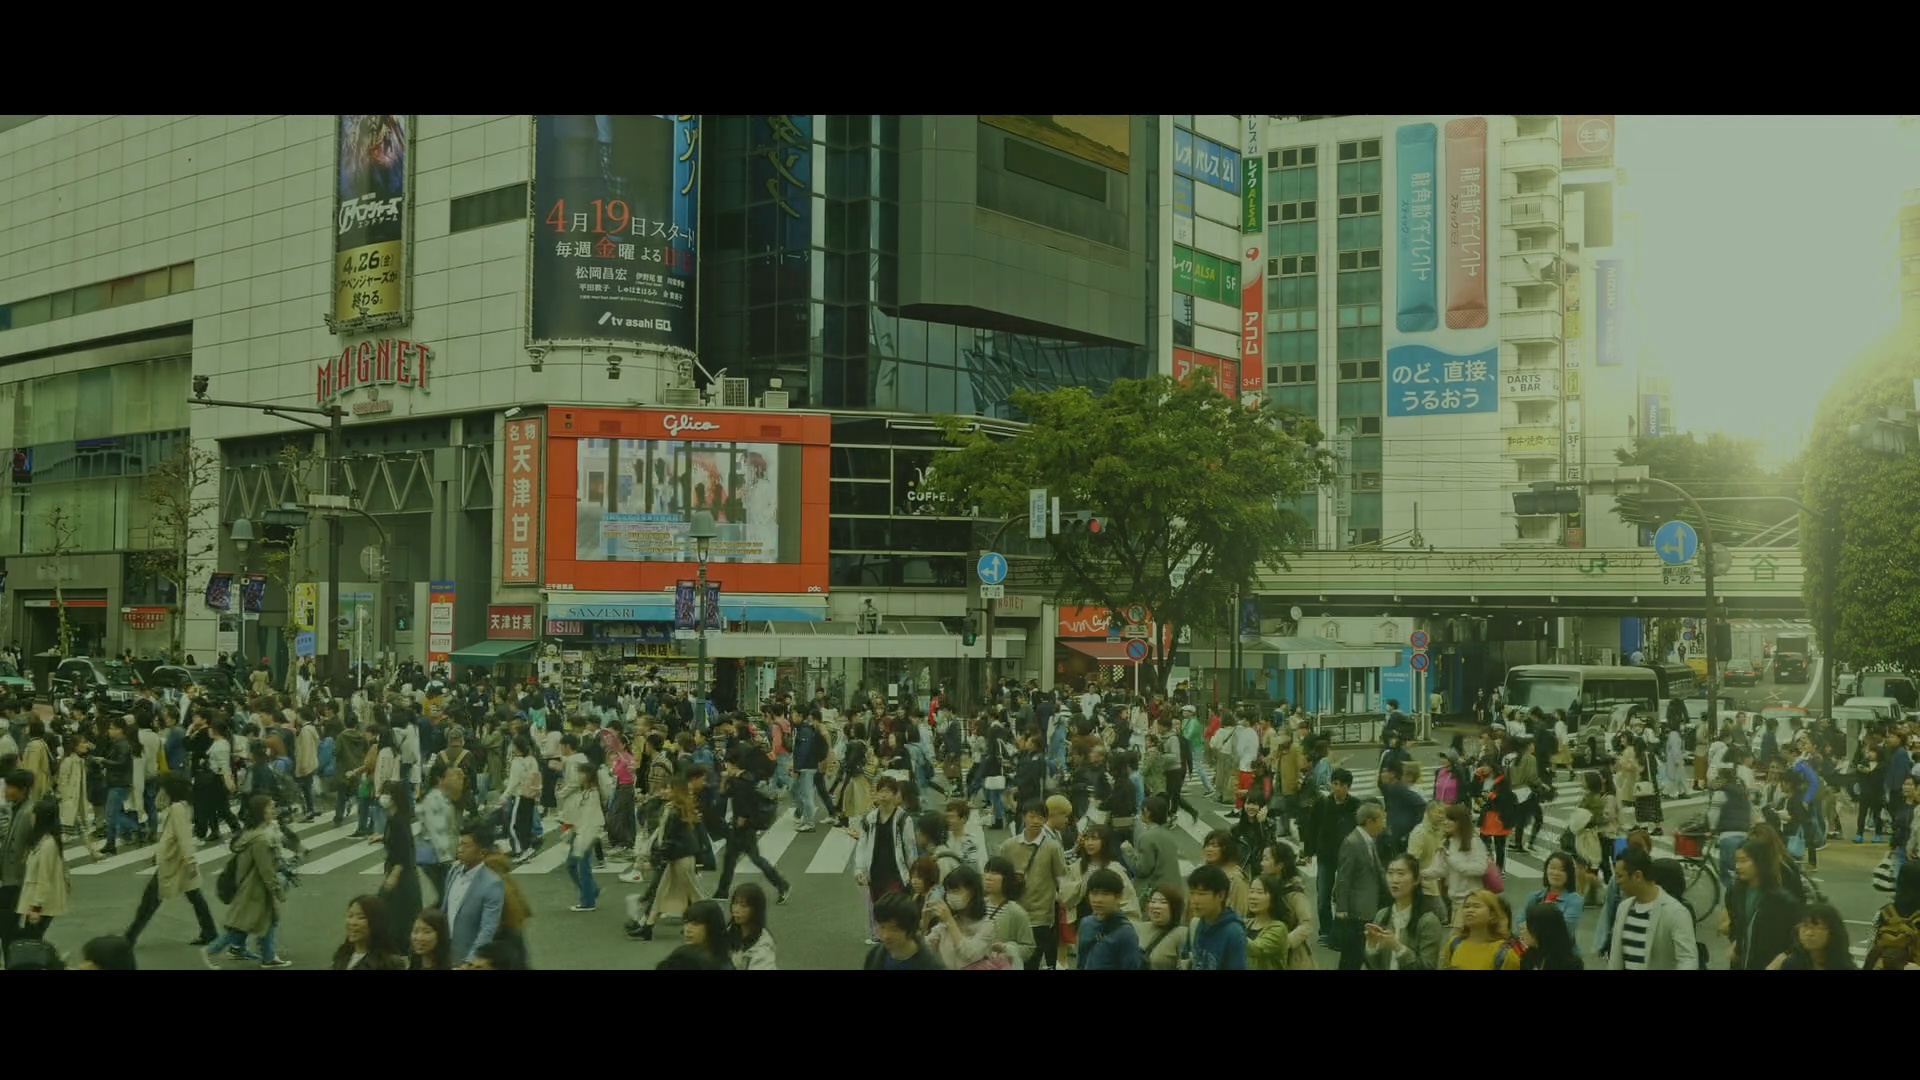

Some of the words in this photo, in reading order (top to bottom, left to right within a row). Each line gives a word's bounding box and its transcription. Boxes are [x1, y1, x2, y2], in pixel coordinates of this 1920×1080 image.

[1248, 115, 1258, 154] レス21
[678, 115, 699, 194] ゾノ
[1175, 142, 1234, 183] レオパレス21
[1247, 159, 1257, 188] レイク
[1248, 188, 1257, 227] ALSA
[339, 269, 398, 293] アベンジャーズが
[1172, 256, 1193, 273] レイク
[1195, 263, 1216, 280] ALSA
[1226, 275, 1237, 291] 5F
[611, 316, 623, 326] tv
[626, 318, 653, 329] asahi
[1245, 311, 1259, 355] アコム
[316, 338, 430, 404] MAGNET
[1392, 359, 1496, 384] のど、直接、
[1507, 374, 1541, 384] DARTS
[1402, 387, 1479, 411] うるおう
[1520, 383, 1541, 393] BAR
[509, 424, 536, 441] 名物
[663, 414, 720, 437] Glico
[1568, 435, 1579, 444] 3F
[907, 491, 954, 502] COFFE
[511, 445, 531, 577] 天津甘栗
[1580, 558, 1608, 573] JR
[1750, 554, 1779, 581] 谷
[491, 614, 532, 631] 天津甘栗
